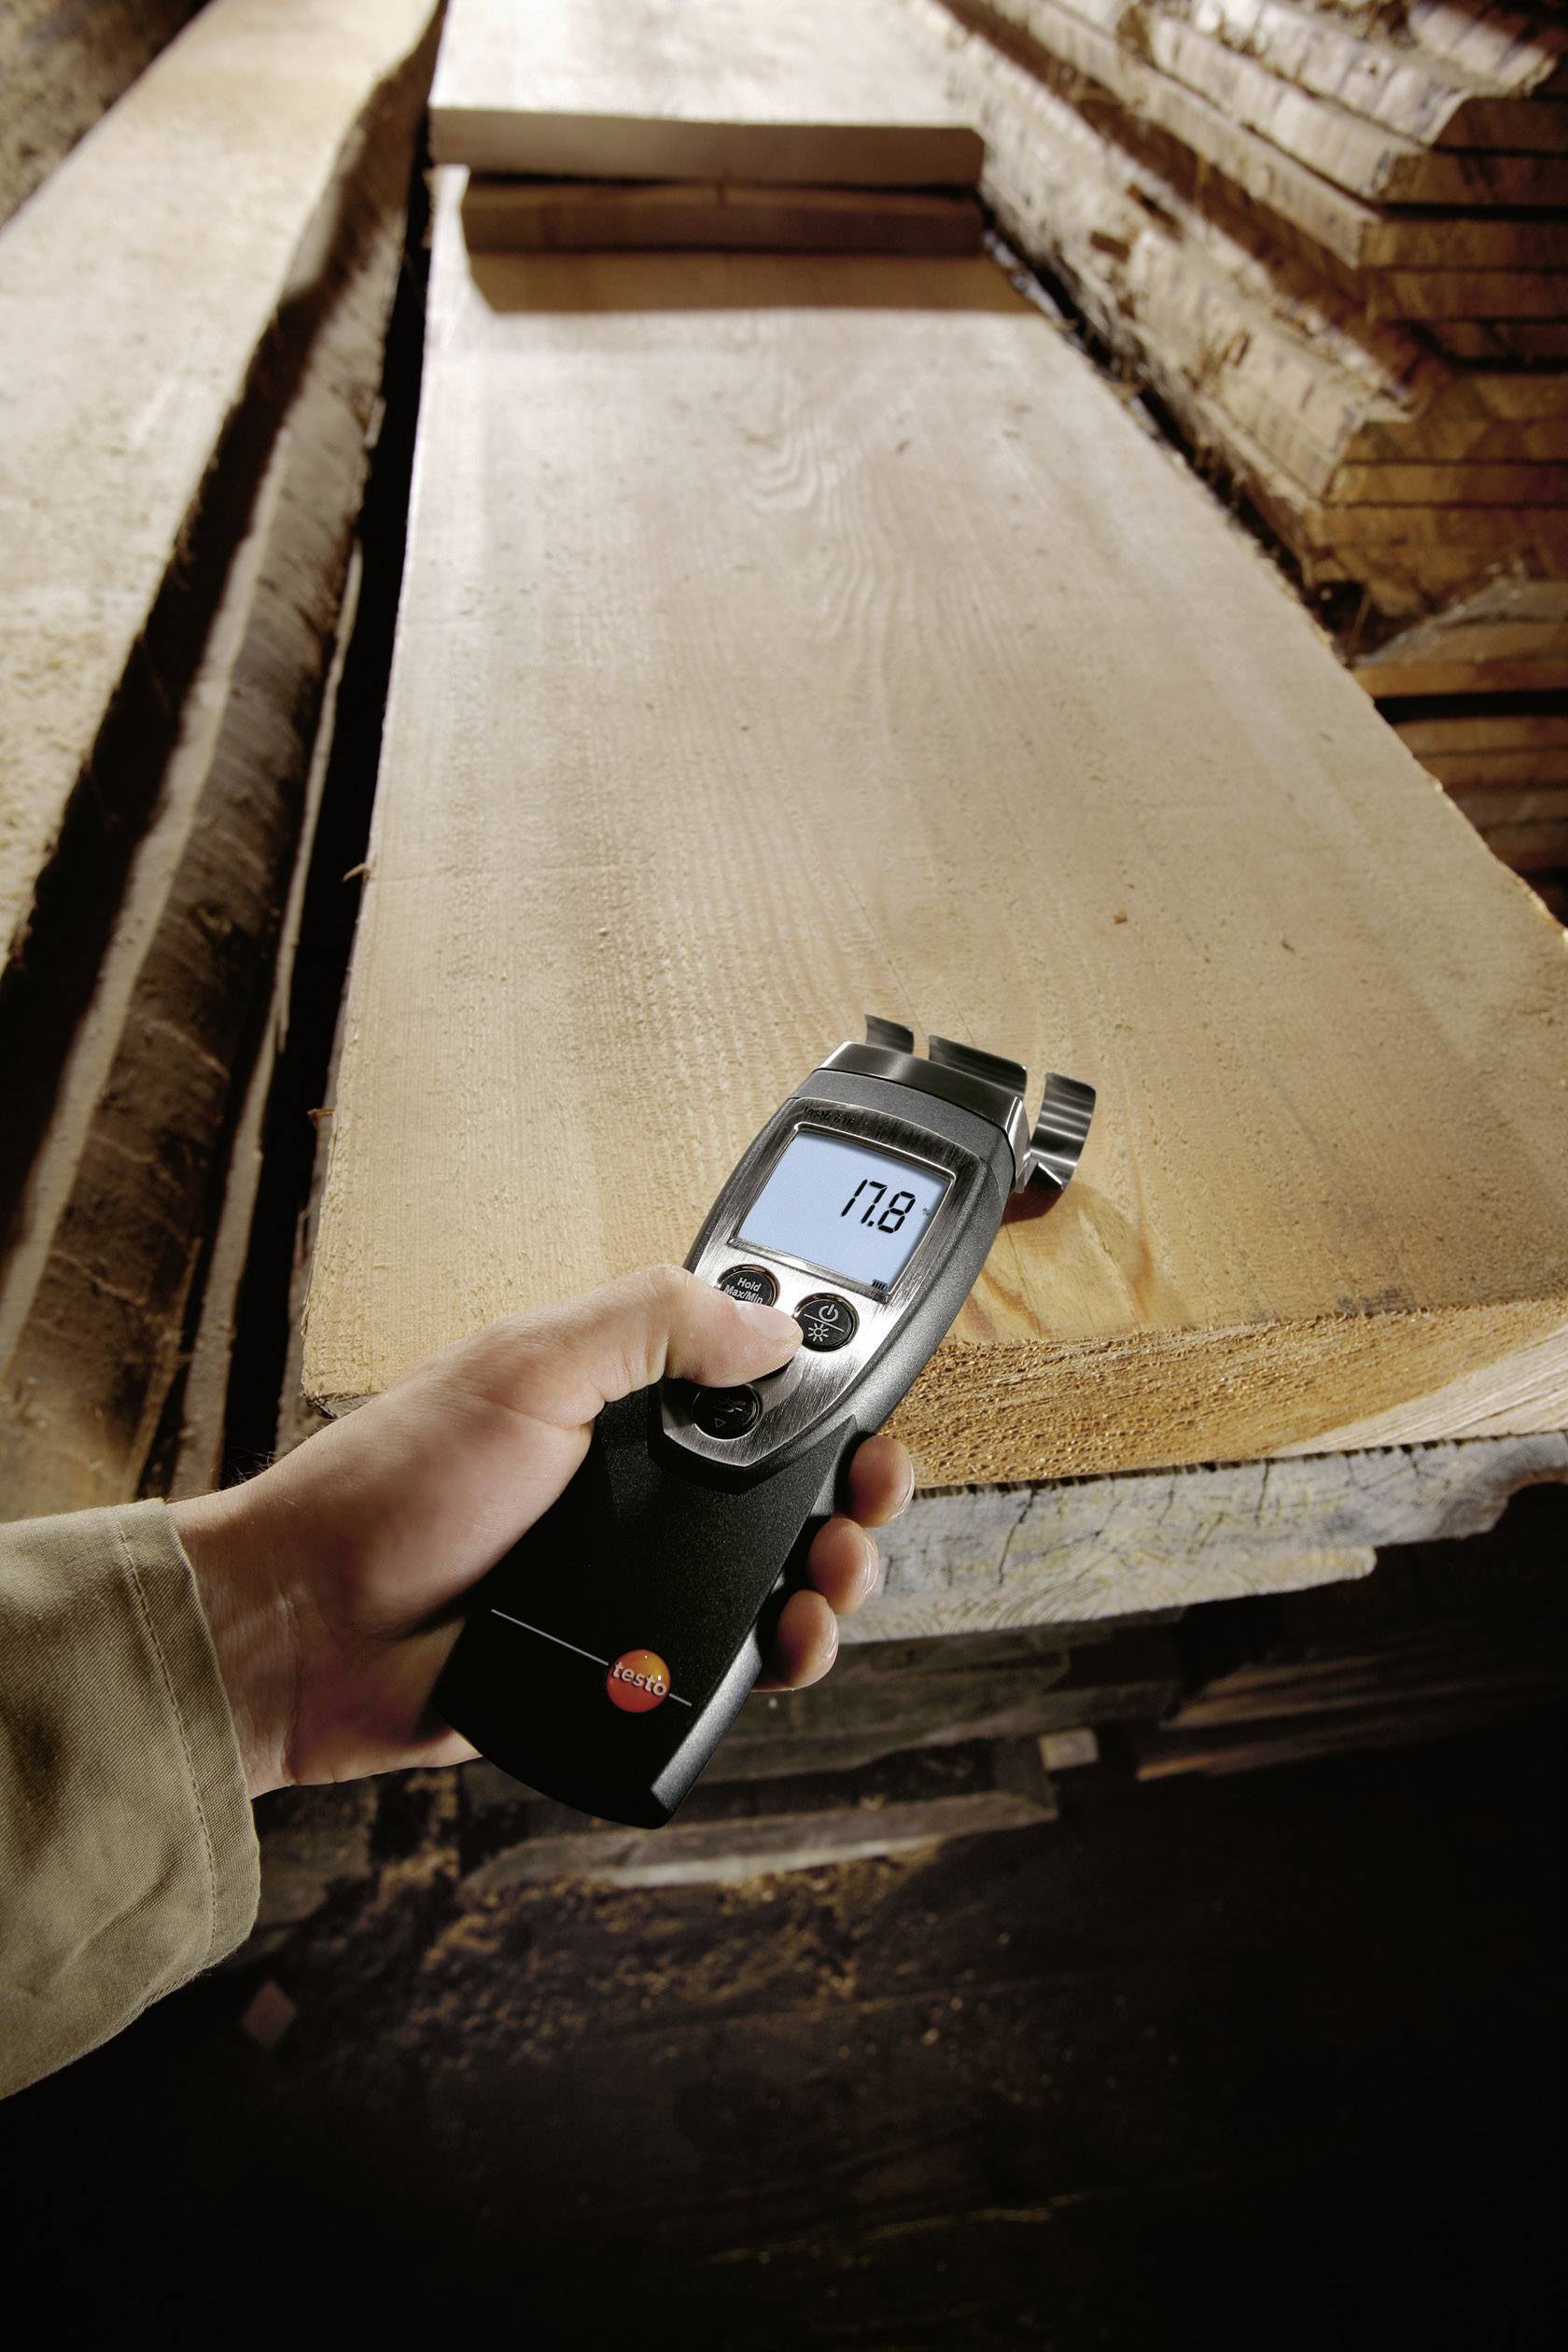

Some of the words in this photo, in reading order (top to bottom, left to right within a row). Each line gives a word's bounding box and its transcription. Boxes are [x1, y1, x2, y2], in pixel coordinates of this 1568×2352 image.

[840, 1179, 916, 1233] 17.8
[724, 1284, 763, 1305] Max/Min
[737, 1277, 762, 1292] Hold
[612, 1661, 666, 1696] testo
